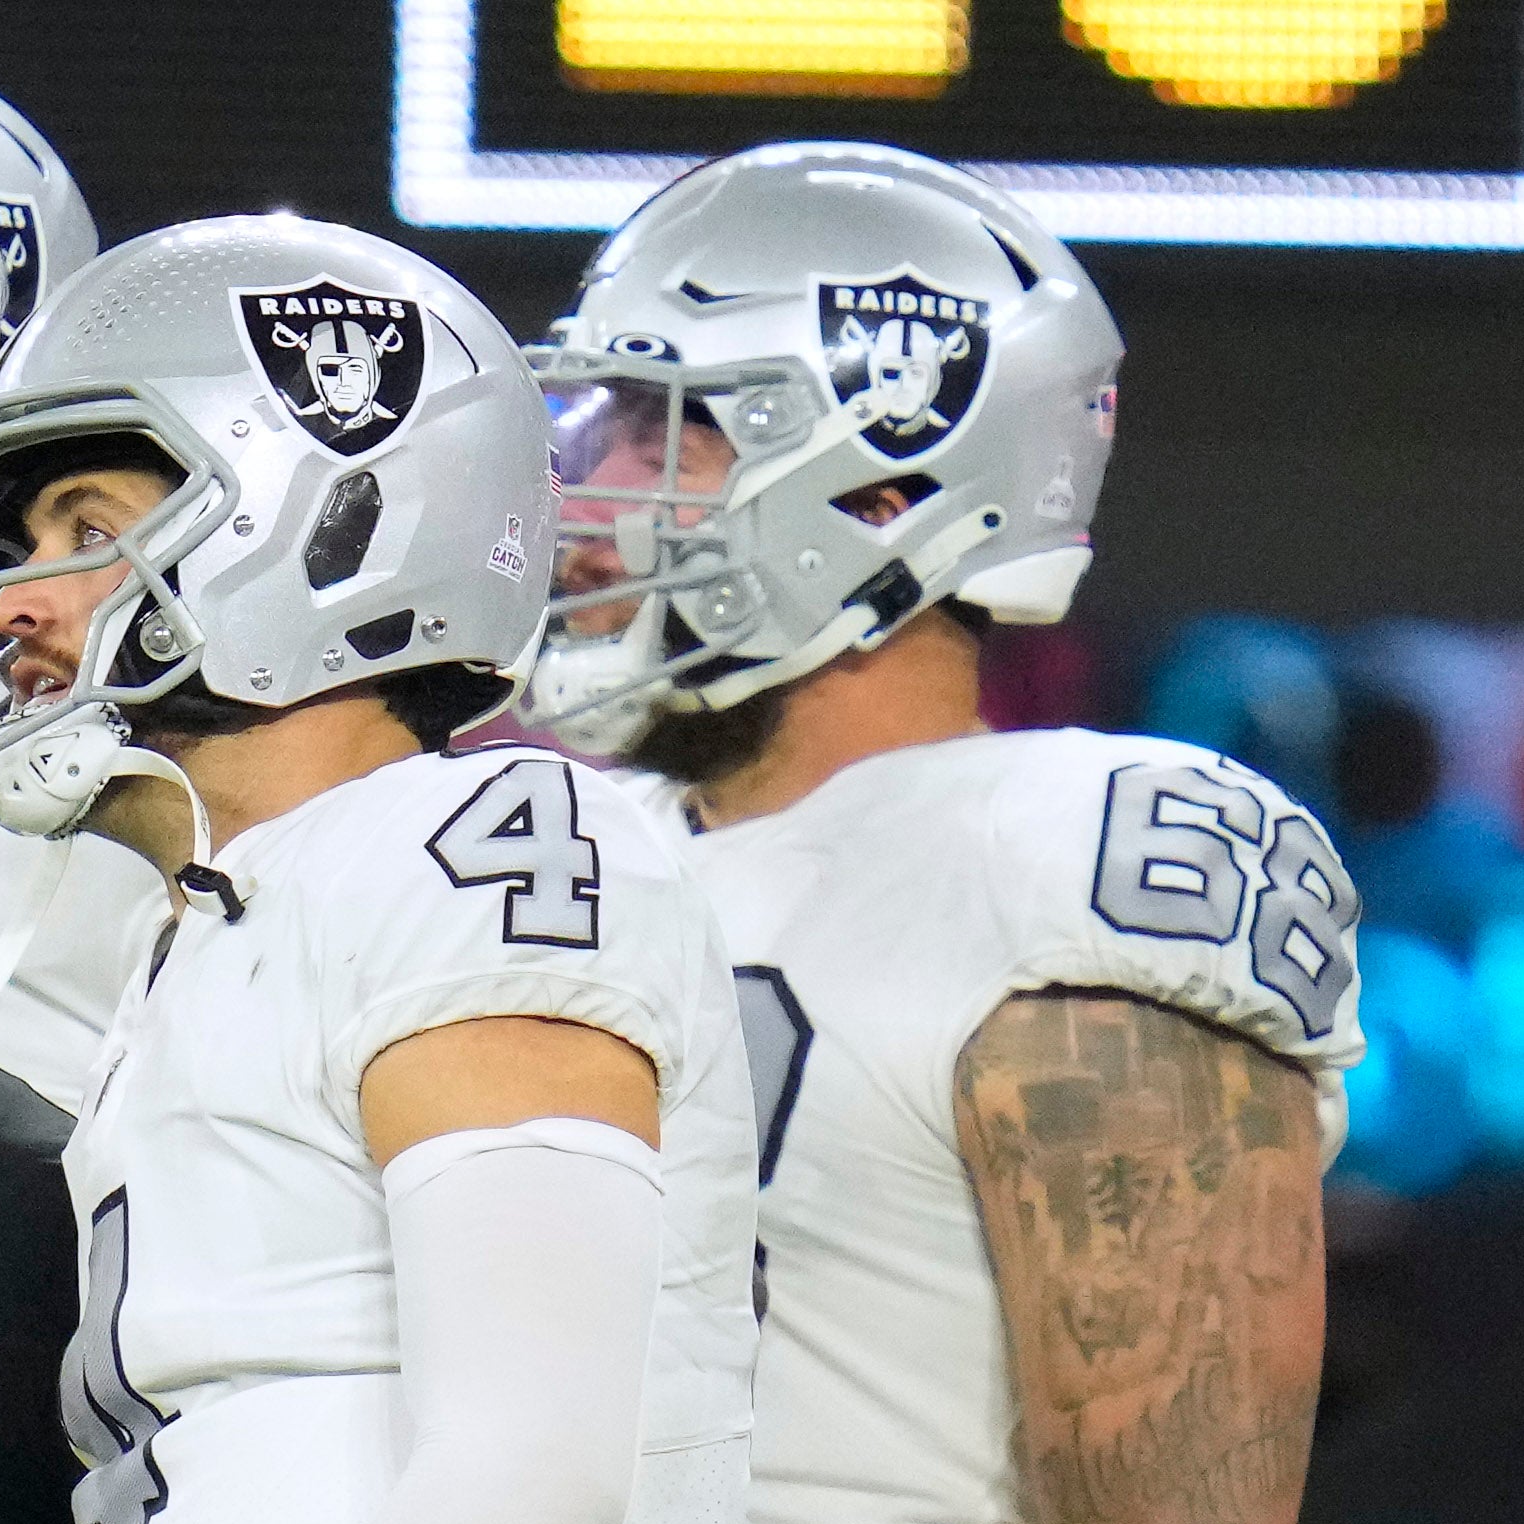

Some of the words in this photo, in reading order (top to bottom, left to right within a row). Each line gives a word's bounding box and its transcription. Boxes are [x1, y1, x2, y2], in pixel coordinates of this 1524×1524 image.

[258, 297, 406, 320] RAIDERS
[834, 287, 979, 323] RAIDERS
[492, 546, 526, 573] CATCH
[424, 758, 602, 952] 4
[1090, 762, 1360, 1042] 68
